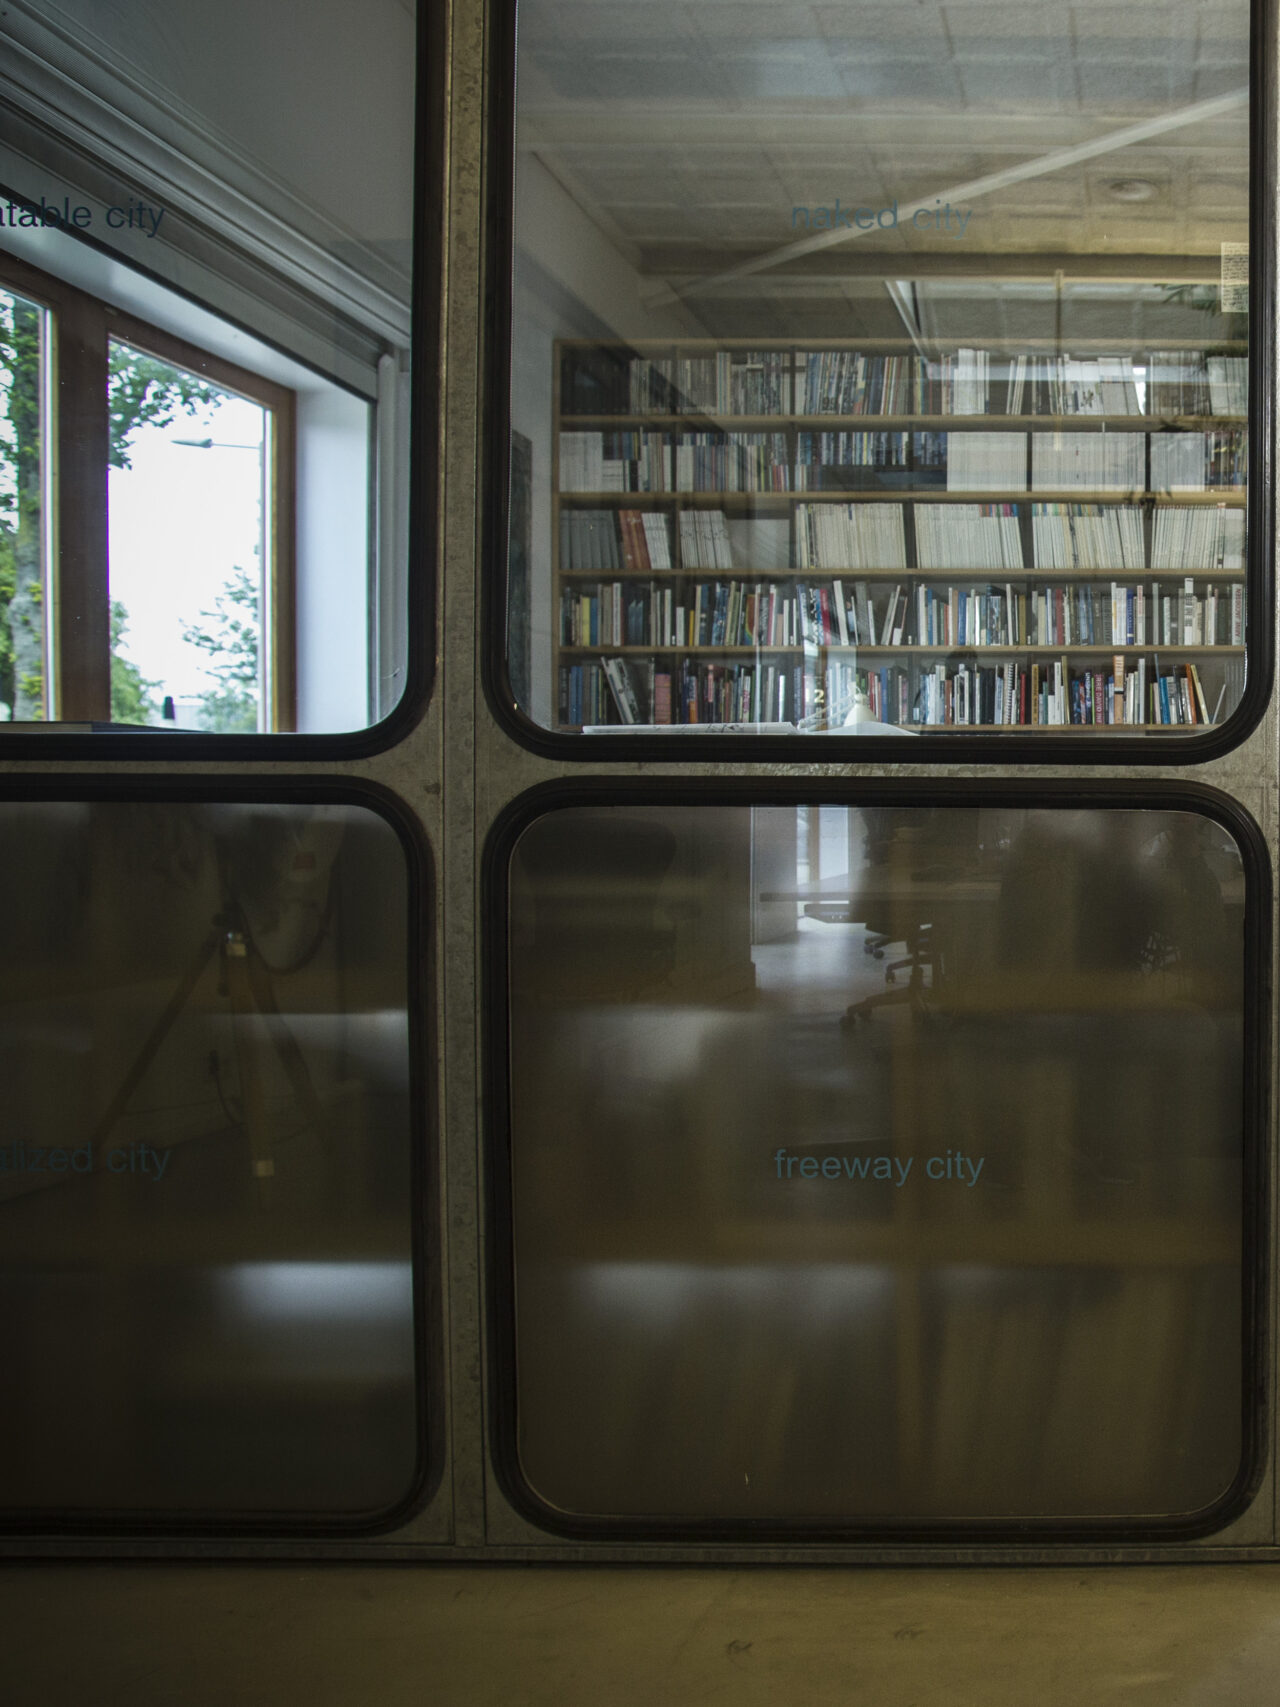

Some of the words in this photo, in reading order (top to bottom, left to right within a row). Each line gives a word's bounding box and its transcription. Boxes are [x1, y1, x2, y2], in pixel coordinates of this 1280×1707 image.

[0, 197, 91, 228] table
[106, 198, 166, 238] city
[791, 198, 898, 230] naked
[912, 199, 973, 239] city
[106, 1142, 171, 1182] city
[774, 1149, 914, 1187] freeway
[925, 1149, 985, 1187] city
